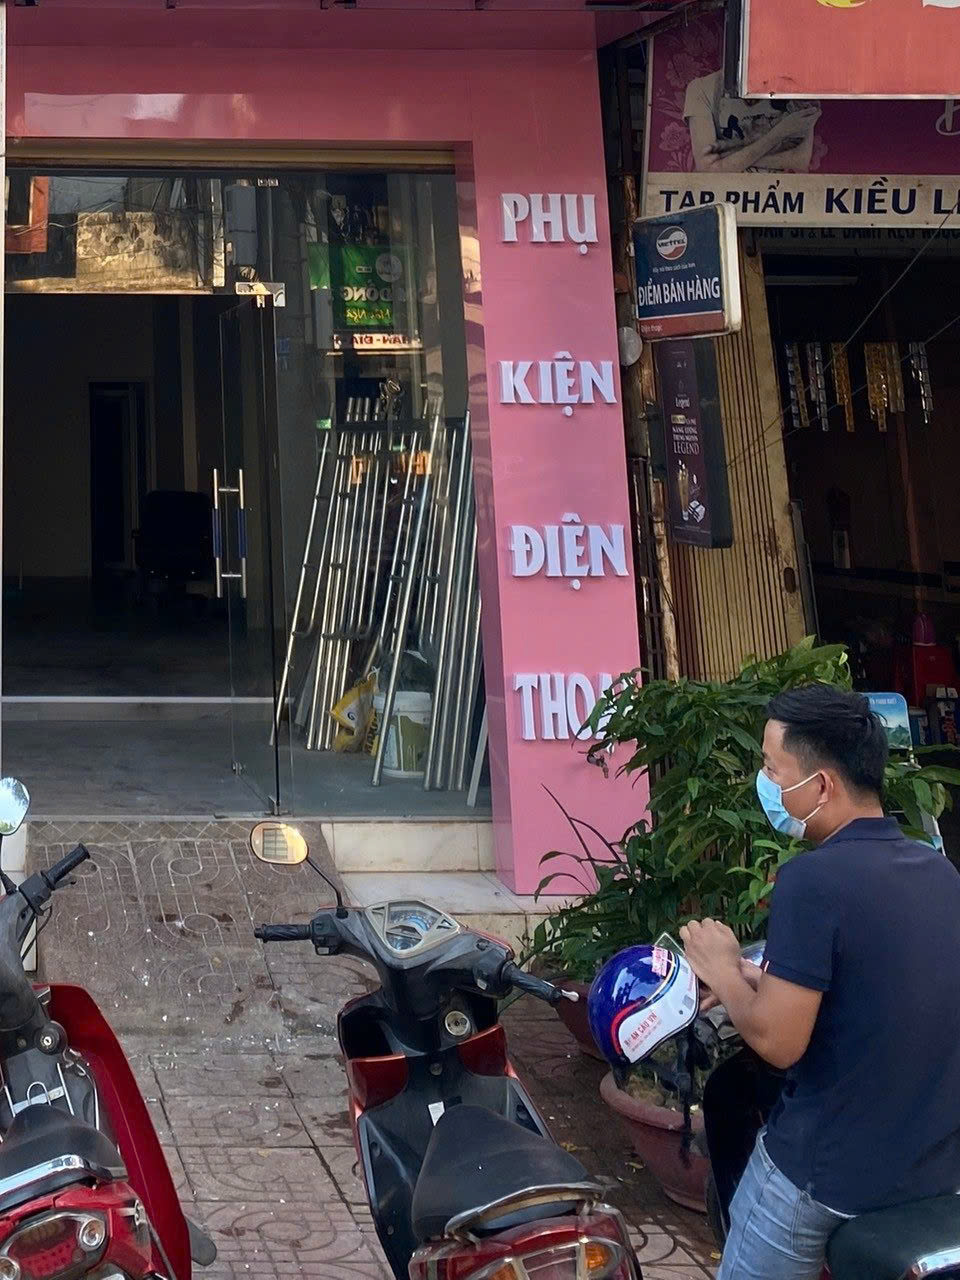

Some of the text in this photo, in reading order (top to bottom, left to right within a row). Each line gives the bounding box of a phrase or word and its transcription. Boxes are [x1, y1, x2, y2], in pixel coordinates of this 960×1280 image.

[500, 193, 599, 255] PHỤ
[825, 176, 917, 214] KIỀU
[638, 275, 720, 306] ĐIỂM BÁN HÀNG
[499, 351, 617, 417] KIỆN
[508, 512, 629, 590] ĐIỆN
